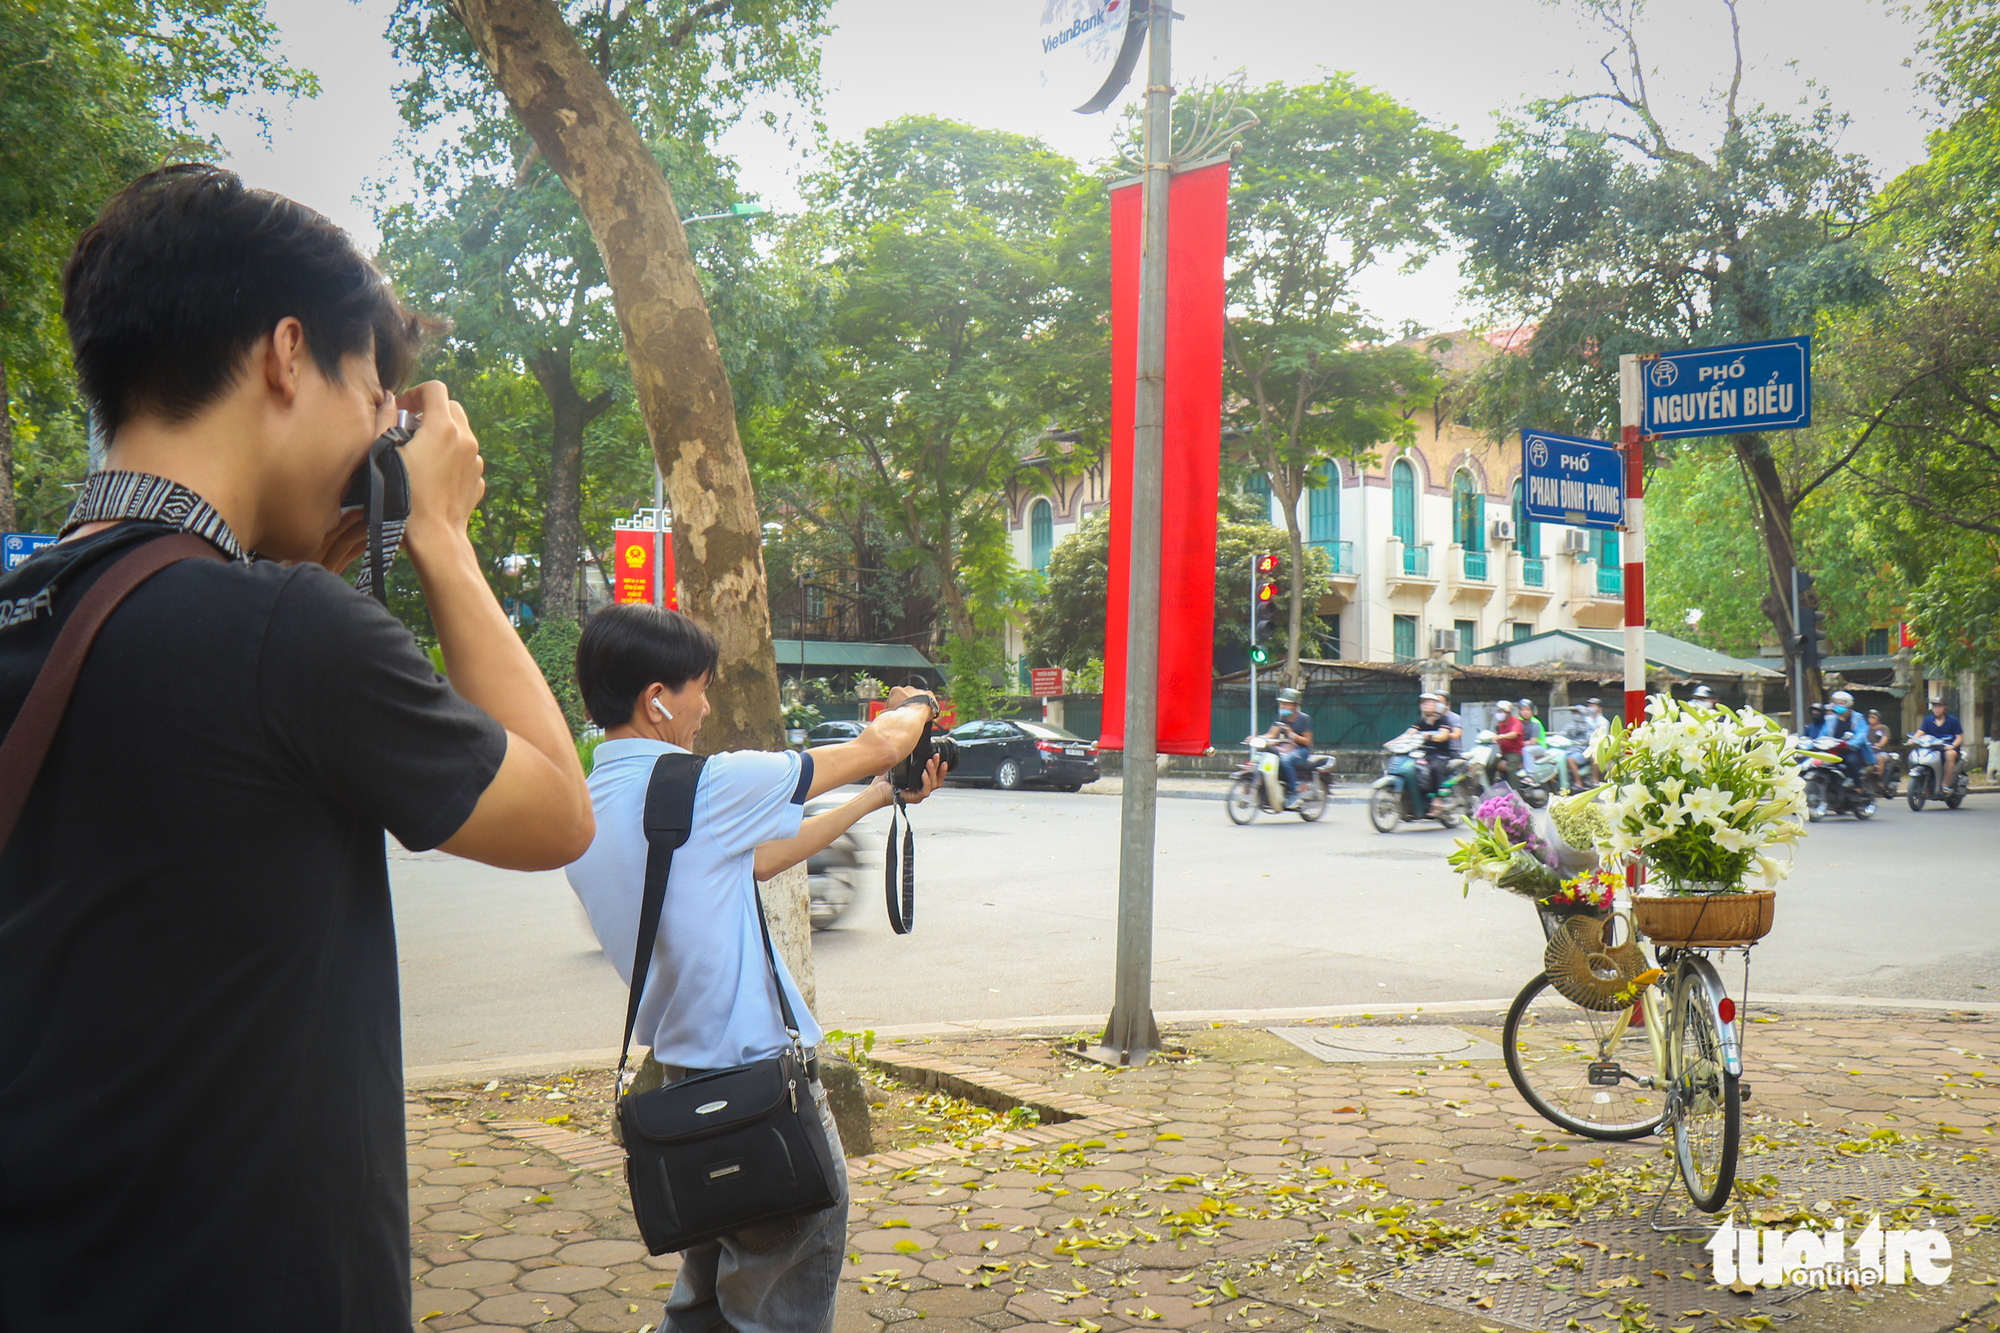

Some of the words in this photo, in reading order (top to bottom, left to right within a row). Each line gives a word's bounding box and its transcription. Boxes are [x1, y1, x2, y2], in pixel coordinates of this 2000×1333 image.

[1042, 8, 1105, 54] VietinBank
[1699, 355, 1746, 382] PHỐ
[1653, 381, 1737, 424] NGUYỄN
[1743, 371, 1794, 417] BIỂU
[1561, 452, 1592, 472] PHỐ
[1530, 475, 1559, 507] PHAN
[1560, 473, 1585, 510] ĐÌNH
[1587, 478, 1620, 514] PHÙNG
